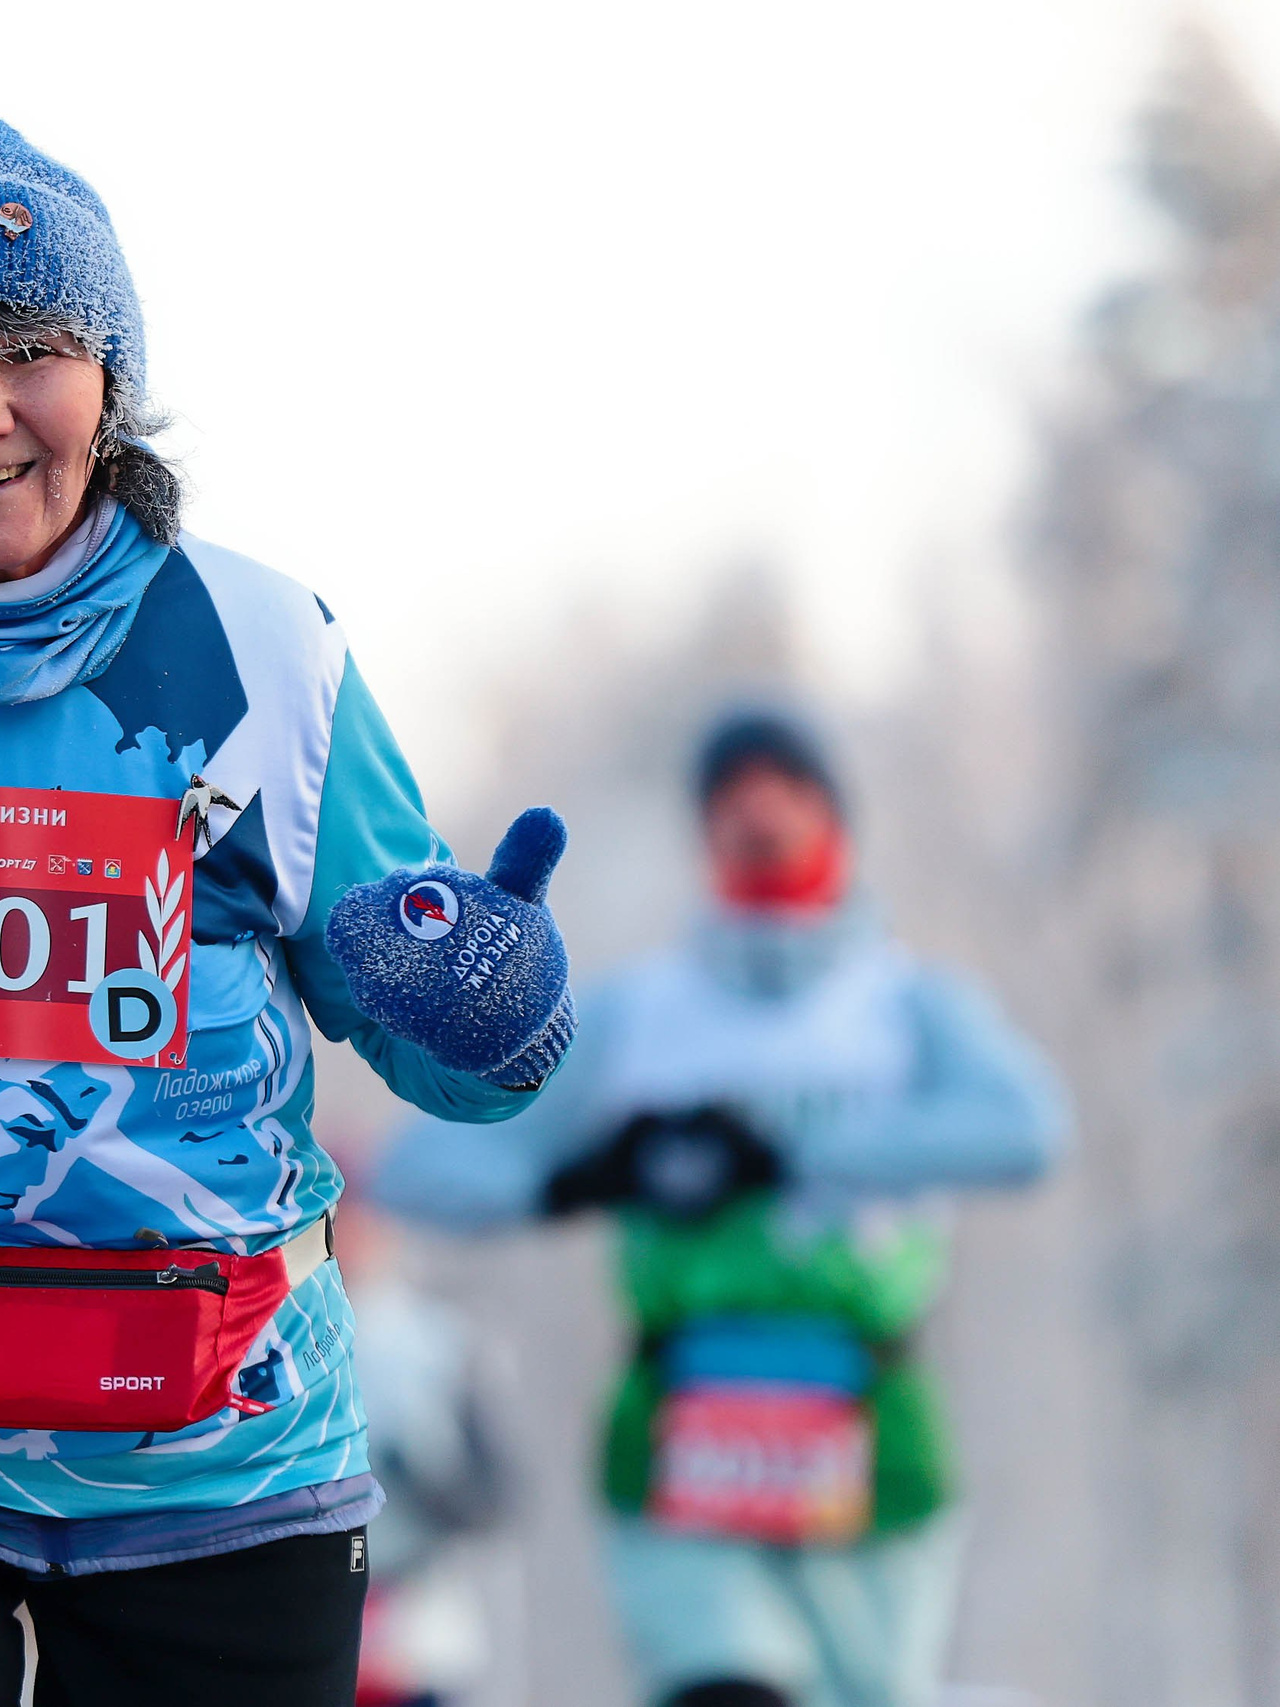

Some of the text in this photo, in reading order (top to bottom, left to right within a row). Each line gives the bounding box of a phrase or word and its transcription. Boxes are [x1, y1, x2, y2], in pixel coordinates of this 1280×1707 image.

[451, 913, 507, 980] ДОРОГА
[466, 921, 522, 990] ЖИЗНИ
[107, 986, 163, 1043] D
[153, 1059, 262, 1103] Ладожское
[176, 1092, 232, 1120] озеро
[100, 1376, 165, 1391] SPORT
